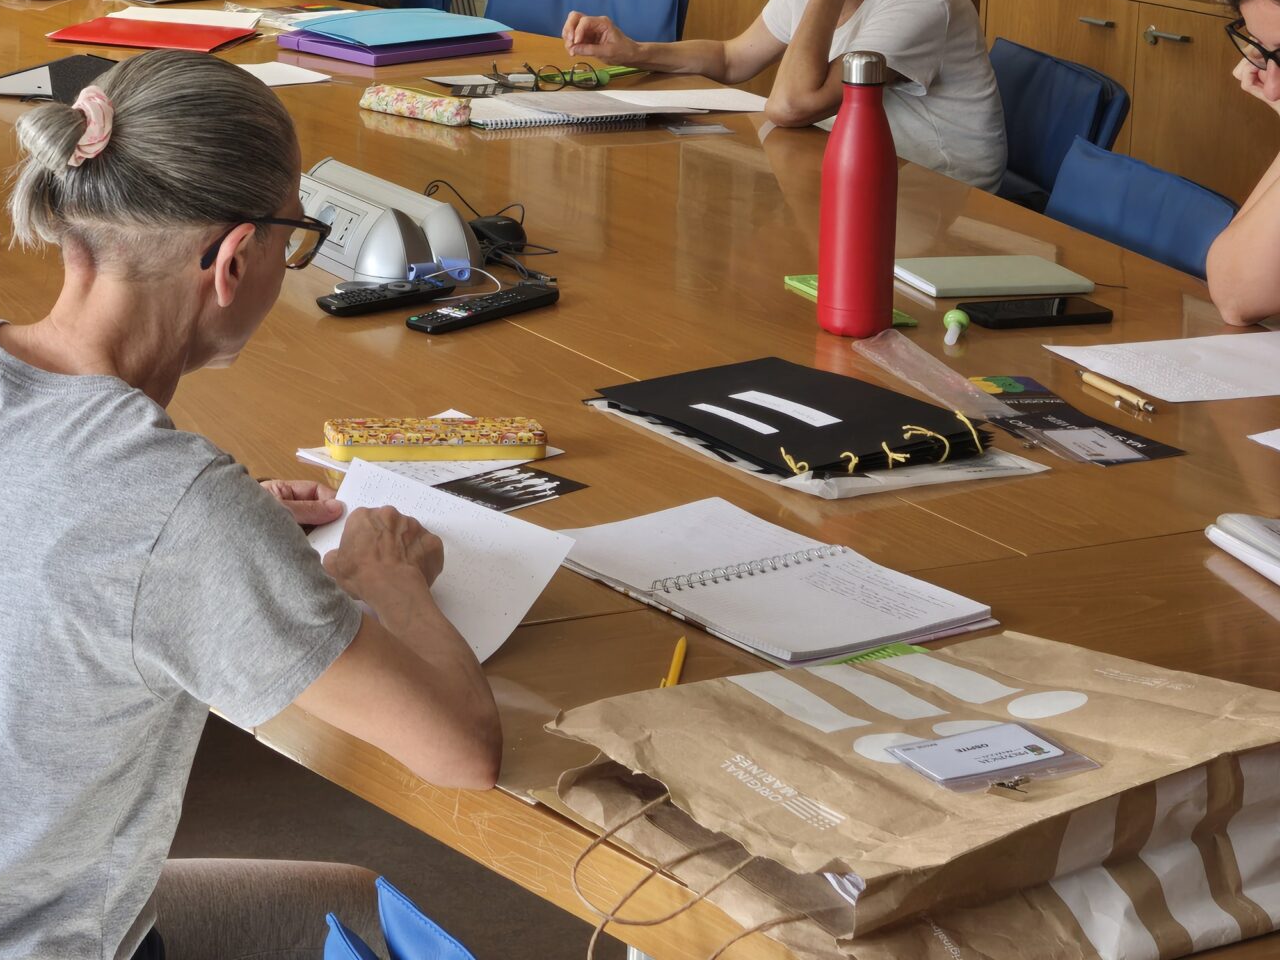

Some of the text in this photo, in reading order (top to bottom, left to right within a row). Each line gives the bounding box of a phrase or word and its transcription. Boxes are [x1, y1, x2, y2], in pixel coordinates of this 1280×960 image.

[955, 743, 989, 753] OSPITE
[719, 759, 784, 802] ORIGINAL
[730, 753, 798, 798] MARINES
